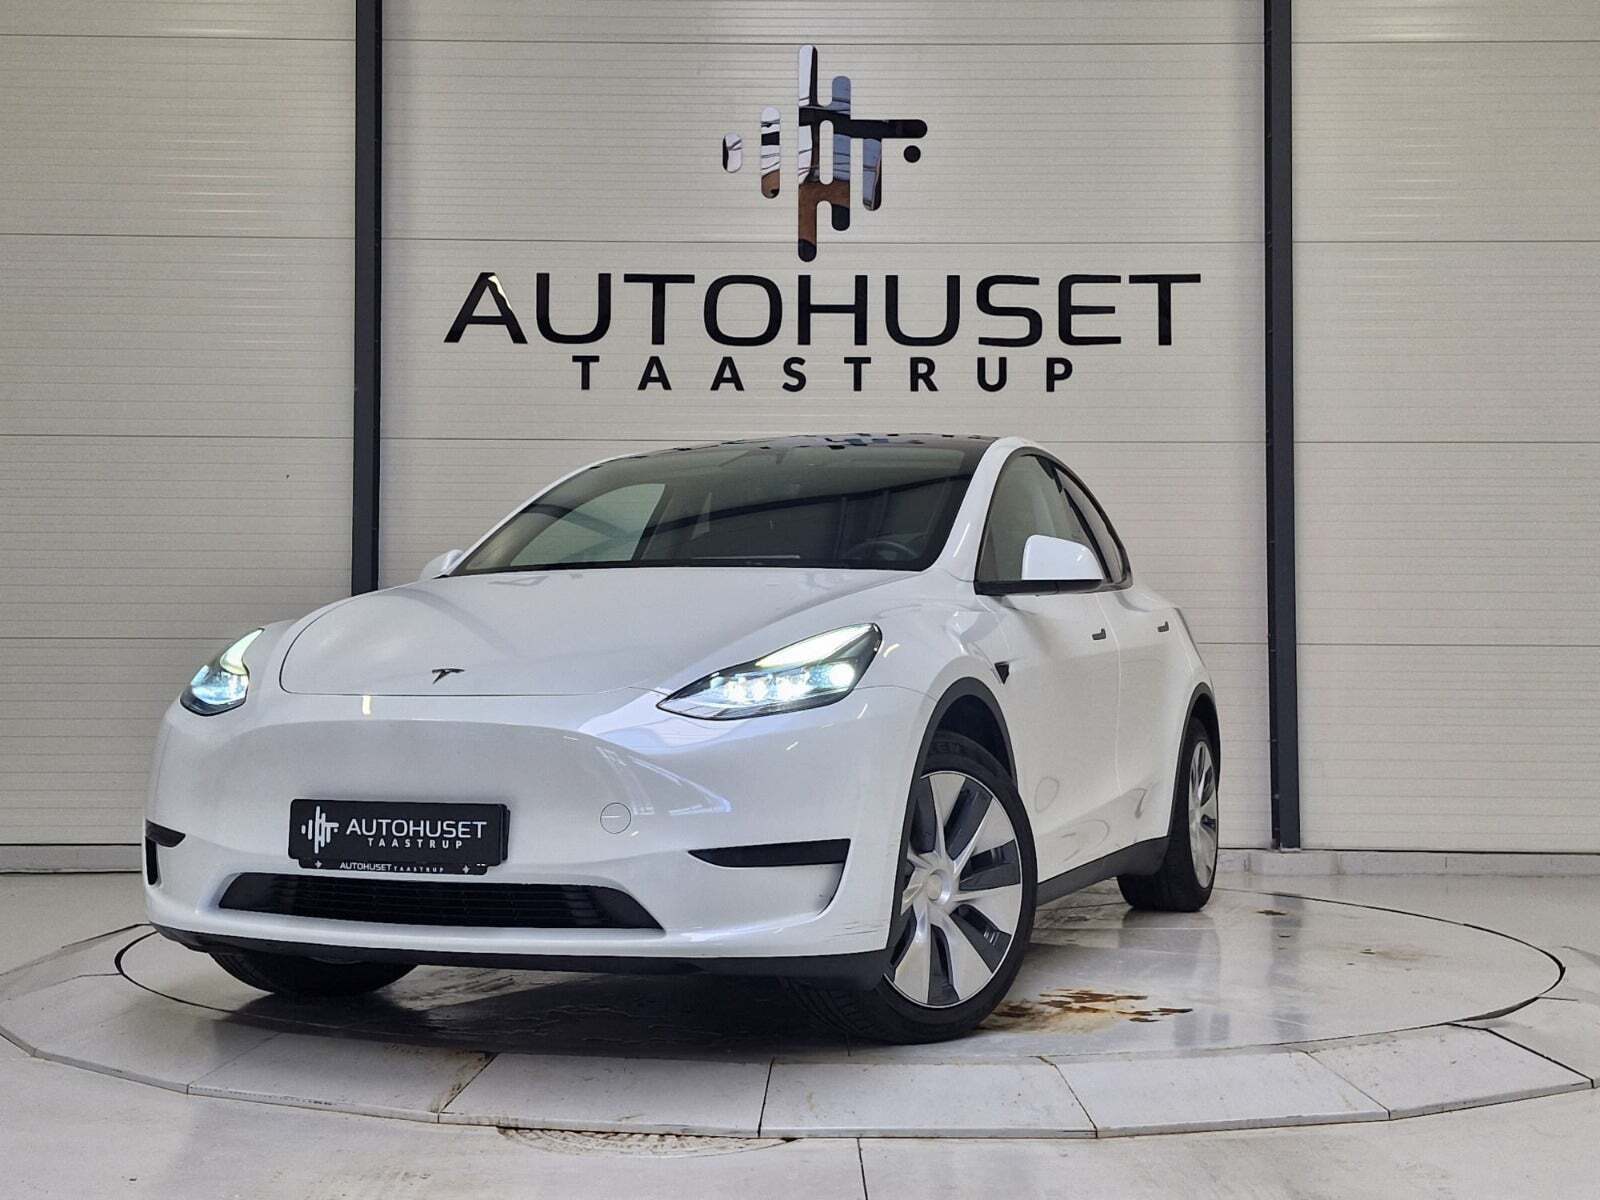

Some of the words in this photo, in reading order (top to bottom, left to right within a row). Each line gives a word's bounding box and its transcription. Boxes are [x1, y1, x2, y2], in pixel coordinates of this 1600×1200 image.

[444, 272, 1201, 347] AUTOHUSET
[572, 356, 1073, 392] TAASTRUP
[346, 818, 487, 838] AUTOHUSET
[368, 838, 462, 849] TAASTRUP
[339, 862, 392, 871] AUTOHUSET
[393, 865, 444, 873] TAASTRUP
